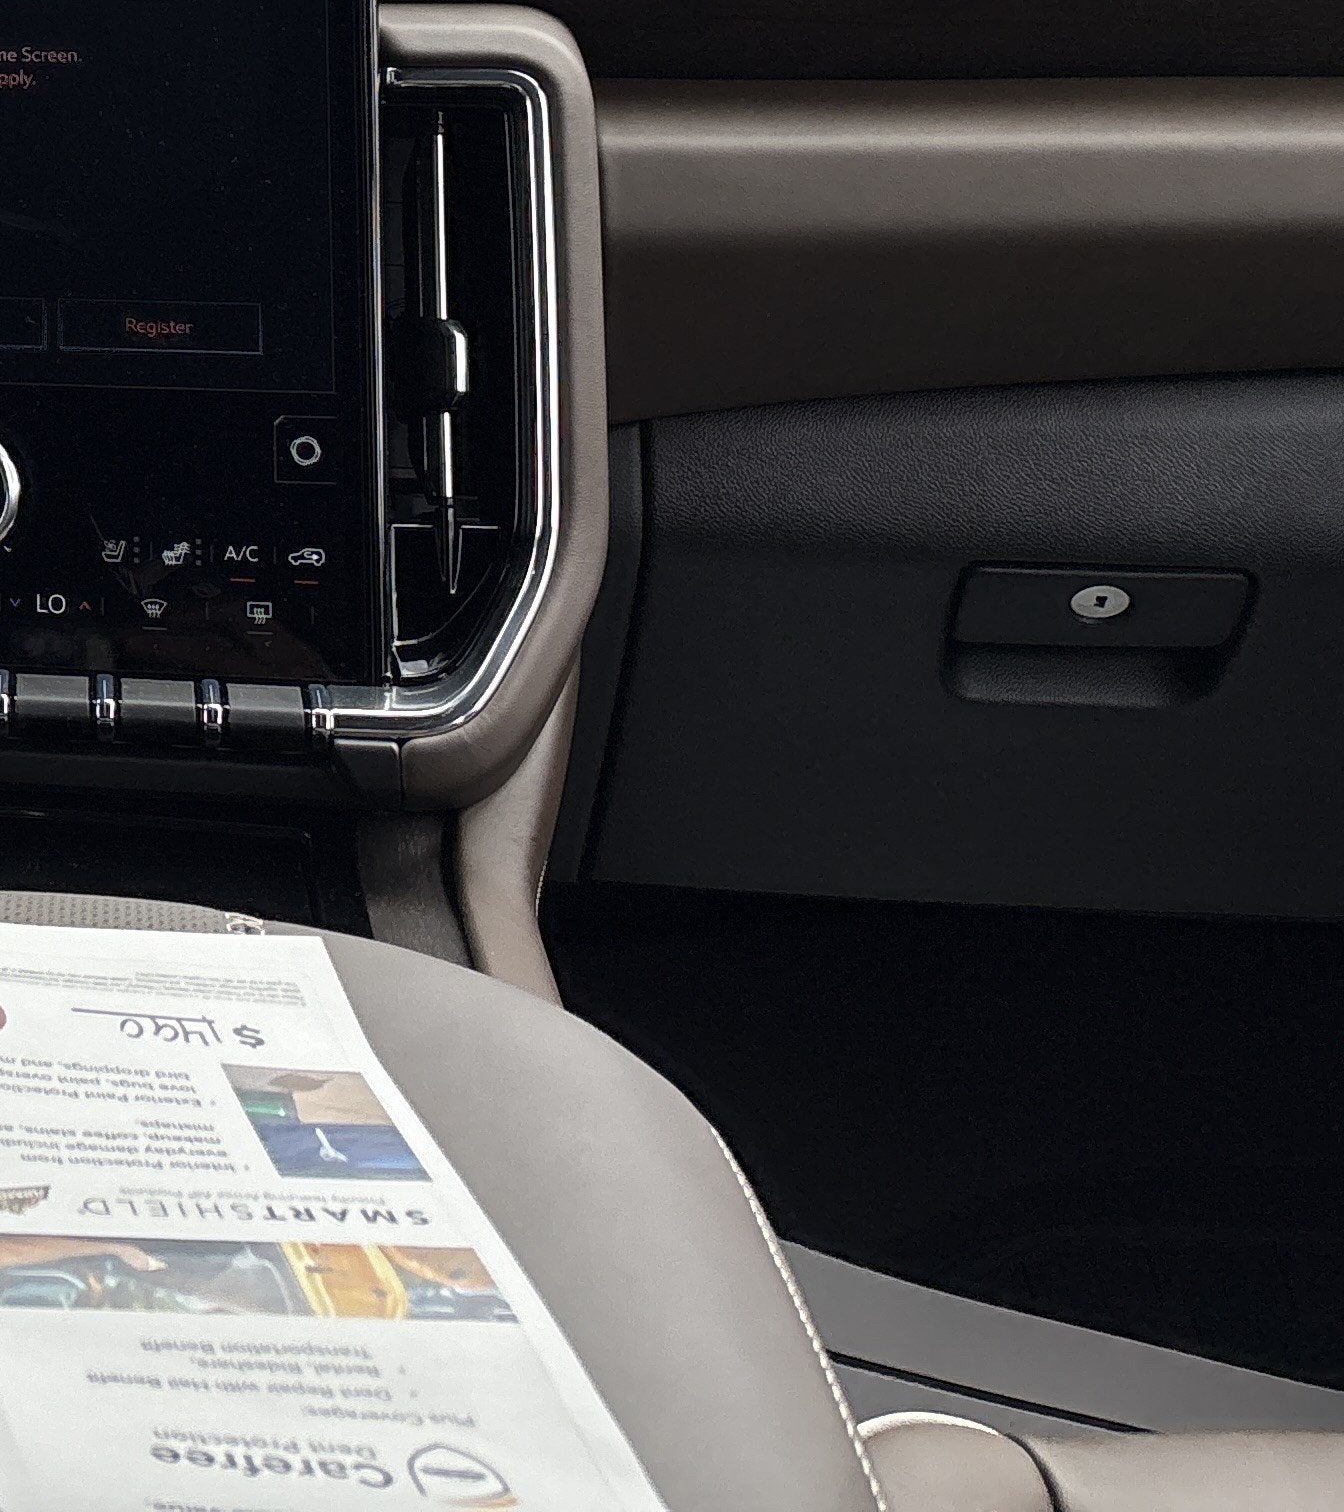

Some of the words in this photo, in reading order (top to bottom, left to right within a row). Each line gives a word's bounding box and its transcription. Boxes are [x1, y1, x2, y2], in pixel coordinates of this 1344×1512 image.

[21, 47, 83, 65] Screen.
[124, 317, 194, 340] Register
[223, 544, 260, 563] A/C
[35, 593, 67, 614] LO
[231, 1024, 265, 1050] $
[21, 1058, 53, 1070] and
[57, 1060, 150, 1078] droppings,
[57, 1075, 101, 1087] paint
[154, 1070, 191, 1082] bird
[105, 1078, 155, 1092] bugs,
[158, 1083, 197, 1095] love
[84, 1091, 129, 1104] Paint
[134, 1094, 202, 1108] Exterior
[19, 1124, 77, 1138] stains,
[81, 1130, 139, 1142] coffee
[142, 1131, 222, 1145] makeup,
[65, 1141, 139, 1155] damage
[144, 1144, 228, 1159] everyday
[20, 1153, 64, 1166] from
[67, 1156, 163, 1171] Protection
[169, 1160, 237, 1174] Interior
[140, 1340, 216, 1355] Benefit
[220, 1341, 374, 1360] Transportation
[86, 1372, 162, 1389] Benefit
[167, 1377, 209, 1391] Hail
[214, 1381, 260, 1393] with
[267, 1383, 335, 1400] Repair
[340, 1387, 393, 1402] Dent
[428, 1412, 477, 1429] Plus
[152, 1427, 301, 1454] Protection
[308, 1442, 377, 1461] Dent
[149, 1445, 395, 1491] Carefree
